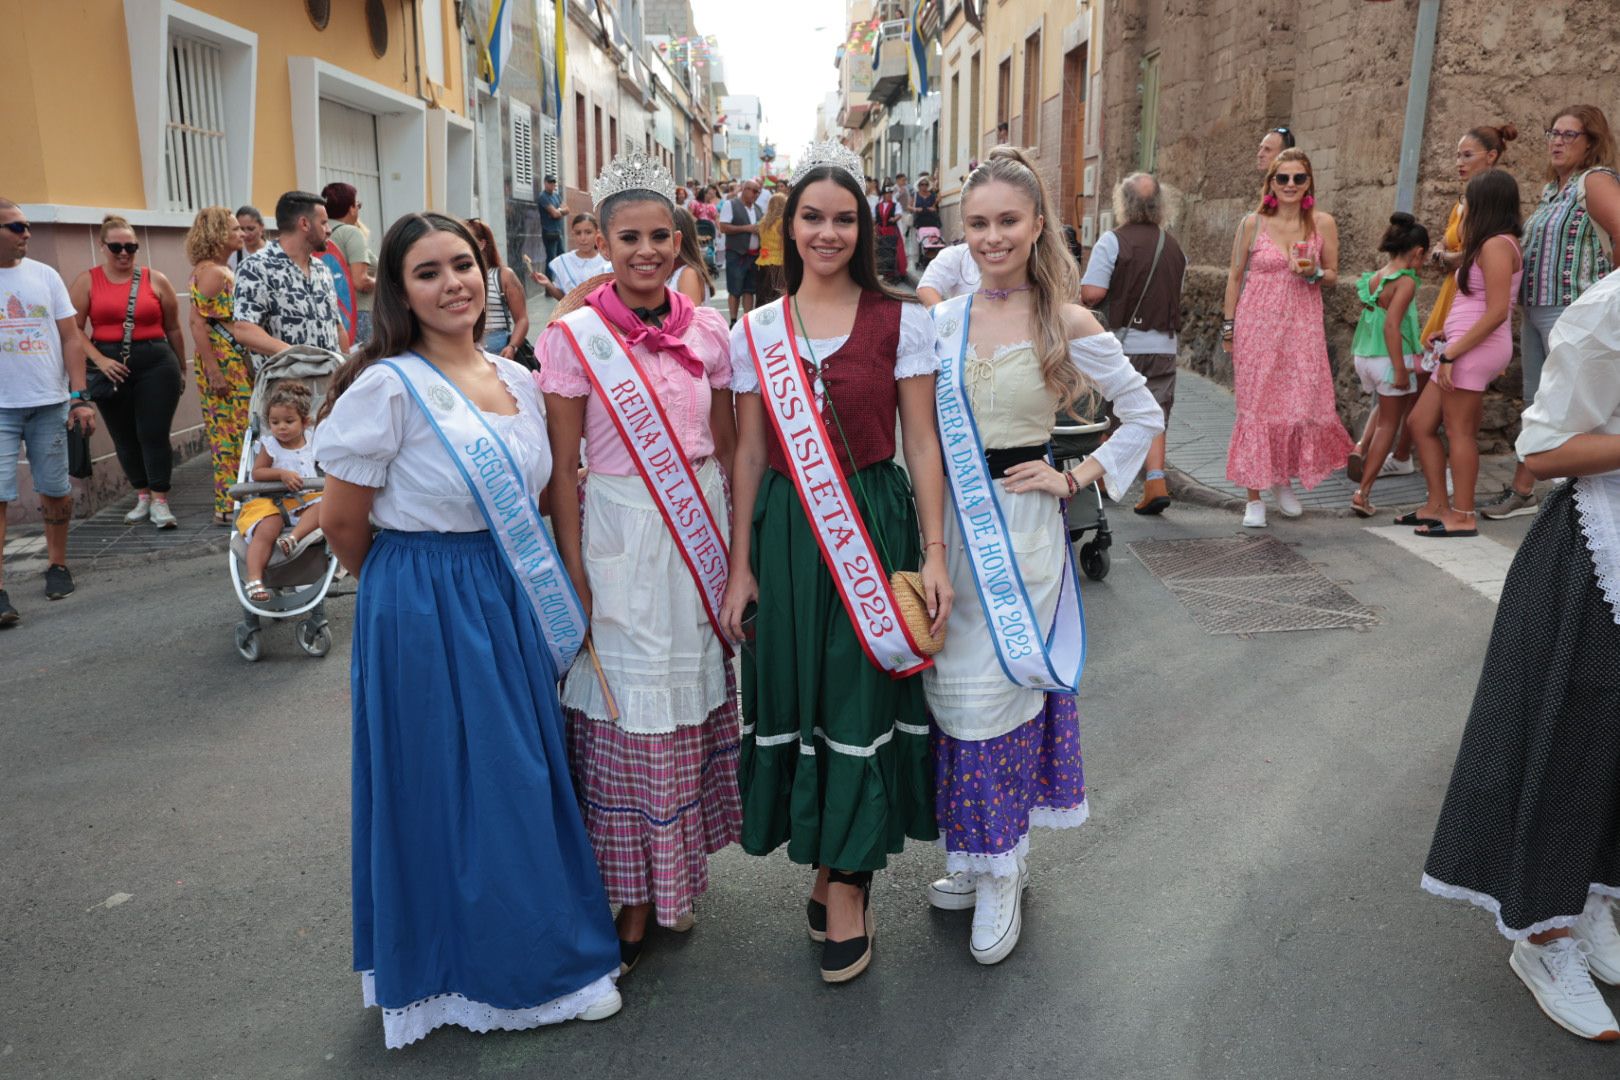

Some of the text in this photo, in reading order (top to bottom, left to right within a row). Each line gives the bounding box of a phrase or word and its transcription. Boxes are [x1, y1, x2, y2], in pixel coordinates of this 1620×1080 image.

[465, 436, 523, 526] SEGUNDA
[610, 379, 662, 452] REINA
[648, 447, 679, 484] DE
[664, 478, 701, 530] LAS
[763, 340, 894, 638] MISS ISLETA 2023
[509, 520, 545, 573] DAMA
[937, 357, 1033, 660] PRIMERA DAMA DE HONOR 2023
[530, 567, 559, 594] DE
[542, 587, 578, 644] HONOR
